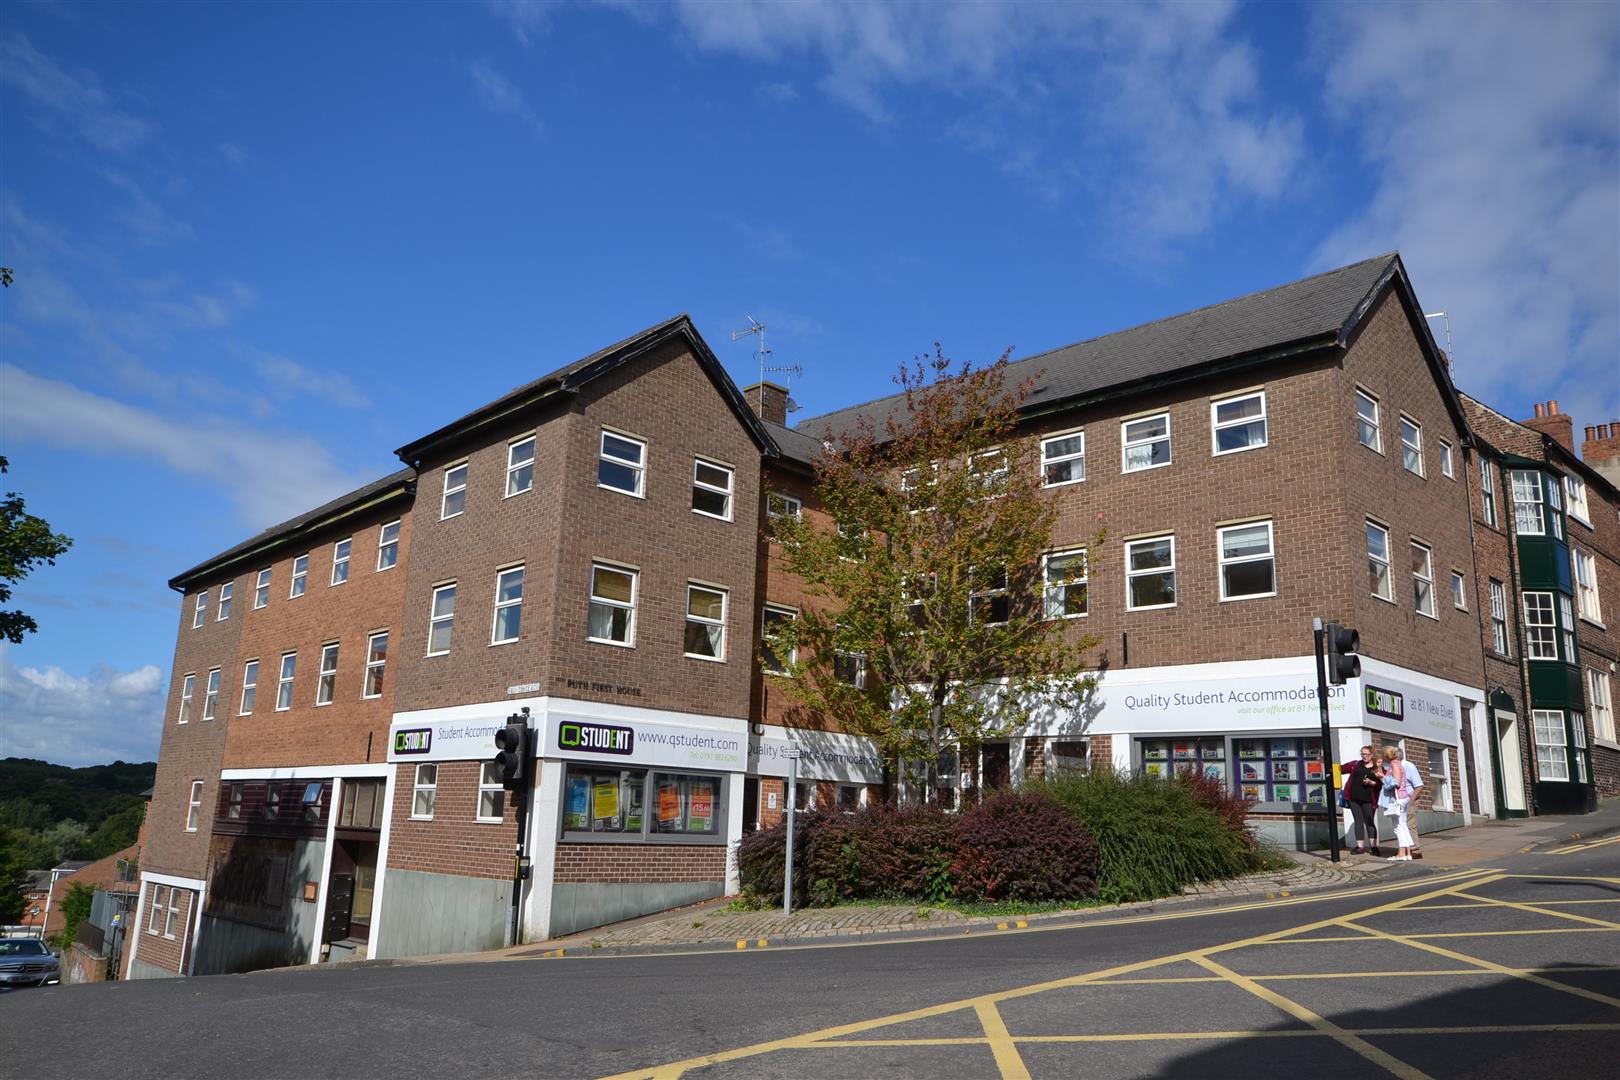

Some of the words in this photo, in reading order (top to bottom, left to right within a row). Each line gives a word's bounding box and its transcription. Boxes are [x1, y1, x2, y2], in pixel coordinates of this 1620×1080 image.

[592, 682, 614, 694] FIRST
[1125, 694, 1170, 710] Quality
[1174, 691, 1224, 706] Student
[1228, 685, 1345, 703] Accommodaon
[1266, 705, 1286, 715] office
[1296, 704, 1306, 712] 81
[1410, 699, 1417, 711] at
[1418, 699, 1425, 711] 81
[1427, 701, 1439, 716] New
[1440, 704, 1454, 720] Elvet
[438, 726, 464, 740] Student
[637, 731, 738, 751] www.qstudent.com
[747, 742, 778, 759] Quality
